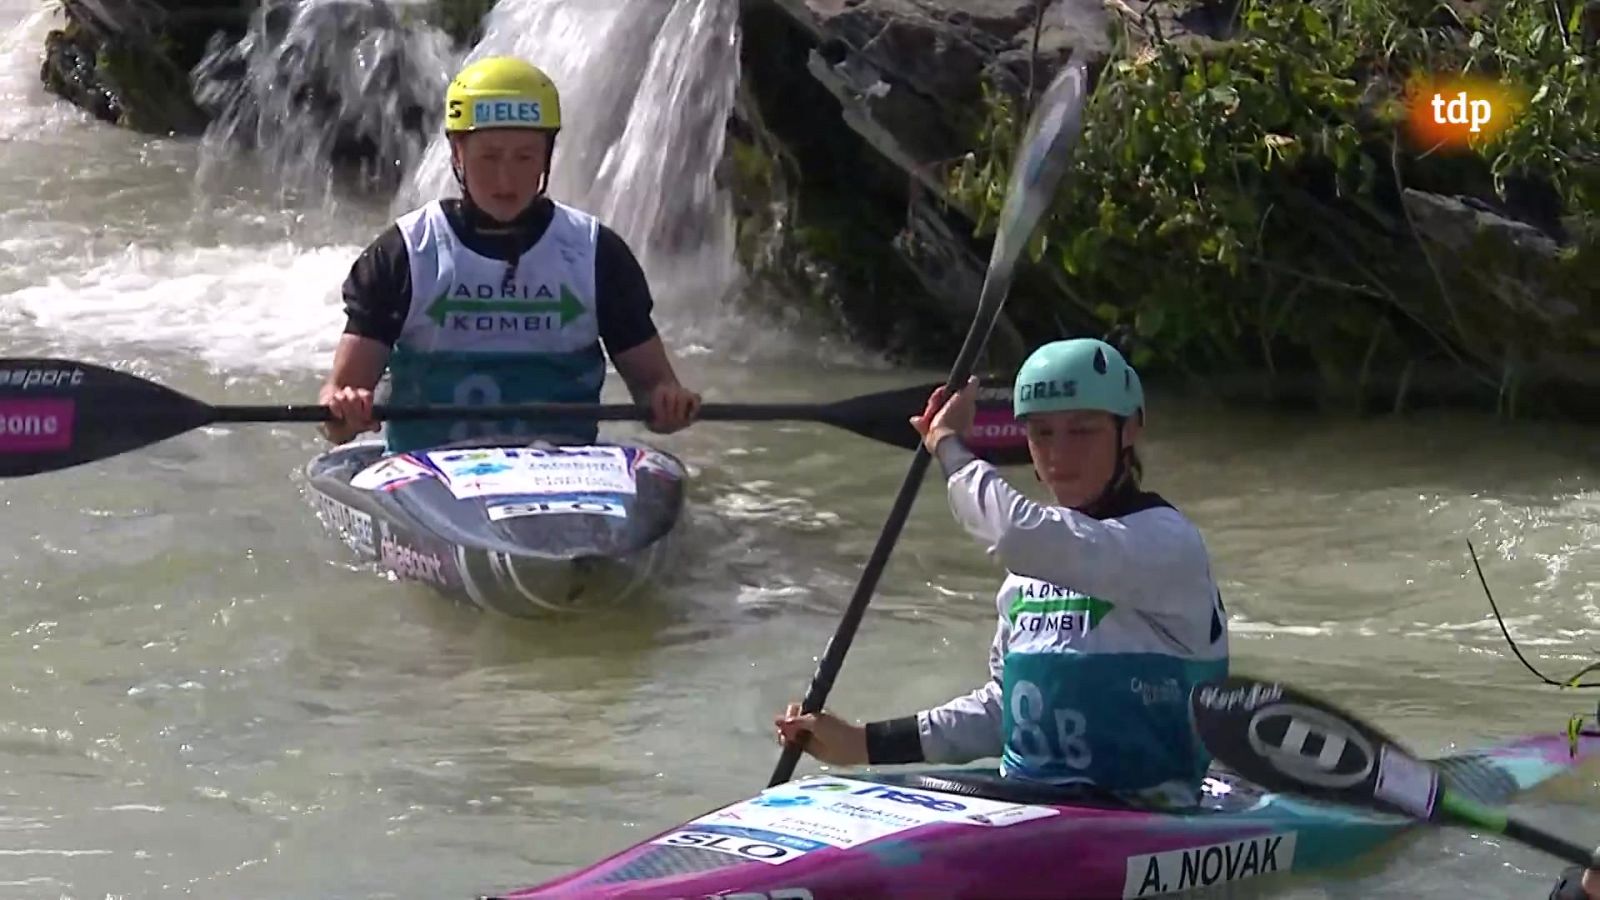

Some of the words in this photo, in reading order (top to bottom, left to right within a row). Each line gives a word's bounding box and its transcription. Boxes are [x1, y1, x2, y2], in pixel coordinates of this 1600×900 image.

[495, 102, 540, 121] ELES
[455, 283, 553, 299] ADRIA
[454, 315, 551, 331] KOMBI
[1019, 614, 1085, 632] KOMBI
[1011, 680, 1050, 766] 8
[1054, 708, 1093, 770] B
[667, 834, 788, 859] SLO
[1138, 855, 1168, 896] A.
[1178, 836, 1283, 890] NOVAK
